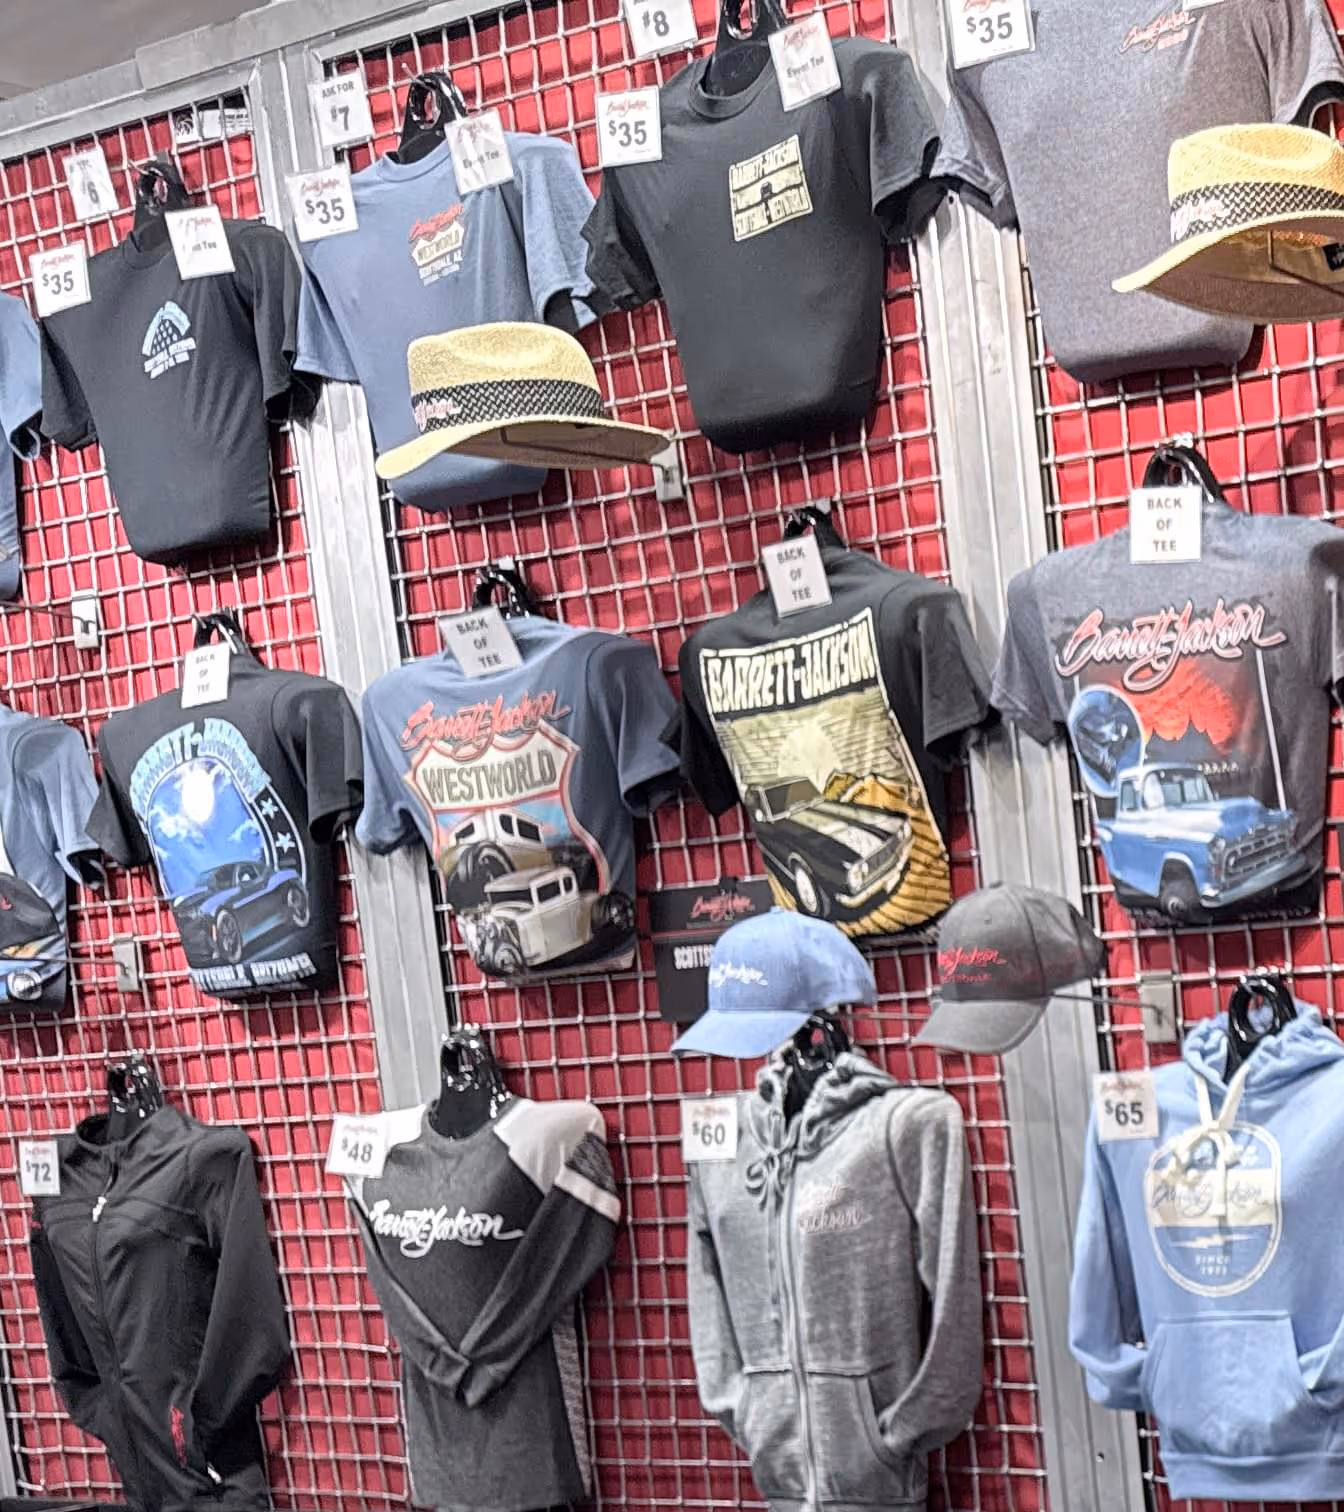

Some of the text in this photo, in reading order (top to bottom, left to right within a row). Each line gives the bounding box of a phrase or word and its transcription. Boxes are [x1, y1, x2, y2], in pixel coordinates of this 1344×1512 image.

[643, 10, 670, 37] #8
[965, 12, 1014, 44] $35
[608, 120, 648, 148] $35
[305, 197, 345, 226] $35
[42, 270, 75, 296] $35
[1146, 496, 1183, 512] BACK
[1155, 517, 1174, 532] OF
[777, 548, 806, 566] BACK
[1152, 539, 1177, 553] TEE
[789, 568, 804, 583] OF
[792, 586, 813, 602] TEE
[456, 618, 489, 637] BACK
[473, 637, 488, 651] OF
[478, 653, 502, 670] TEE
[705, 639, 877, 715] BARRETT-JACKSON
[421, 746, 558, 806] WESTWORLD
[673, 942, 714, 970] SCOTTS
[1104, 1099, 1145, 1127] $65
[692, 1122, 727, 1147] $60
[341, 1137, 373, 1164] $48
[25, 1159, 52, 1183] $72
